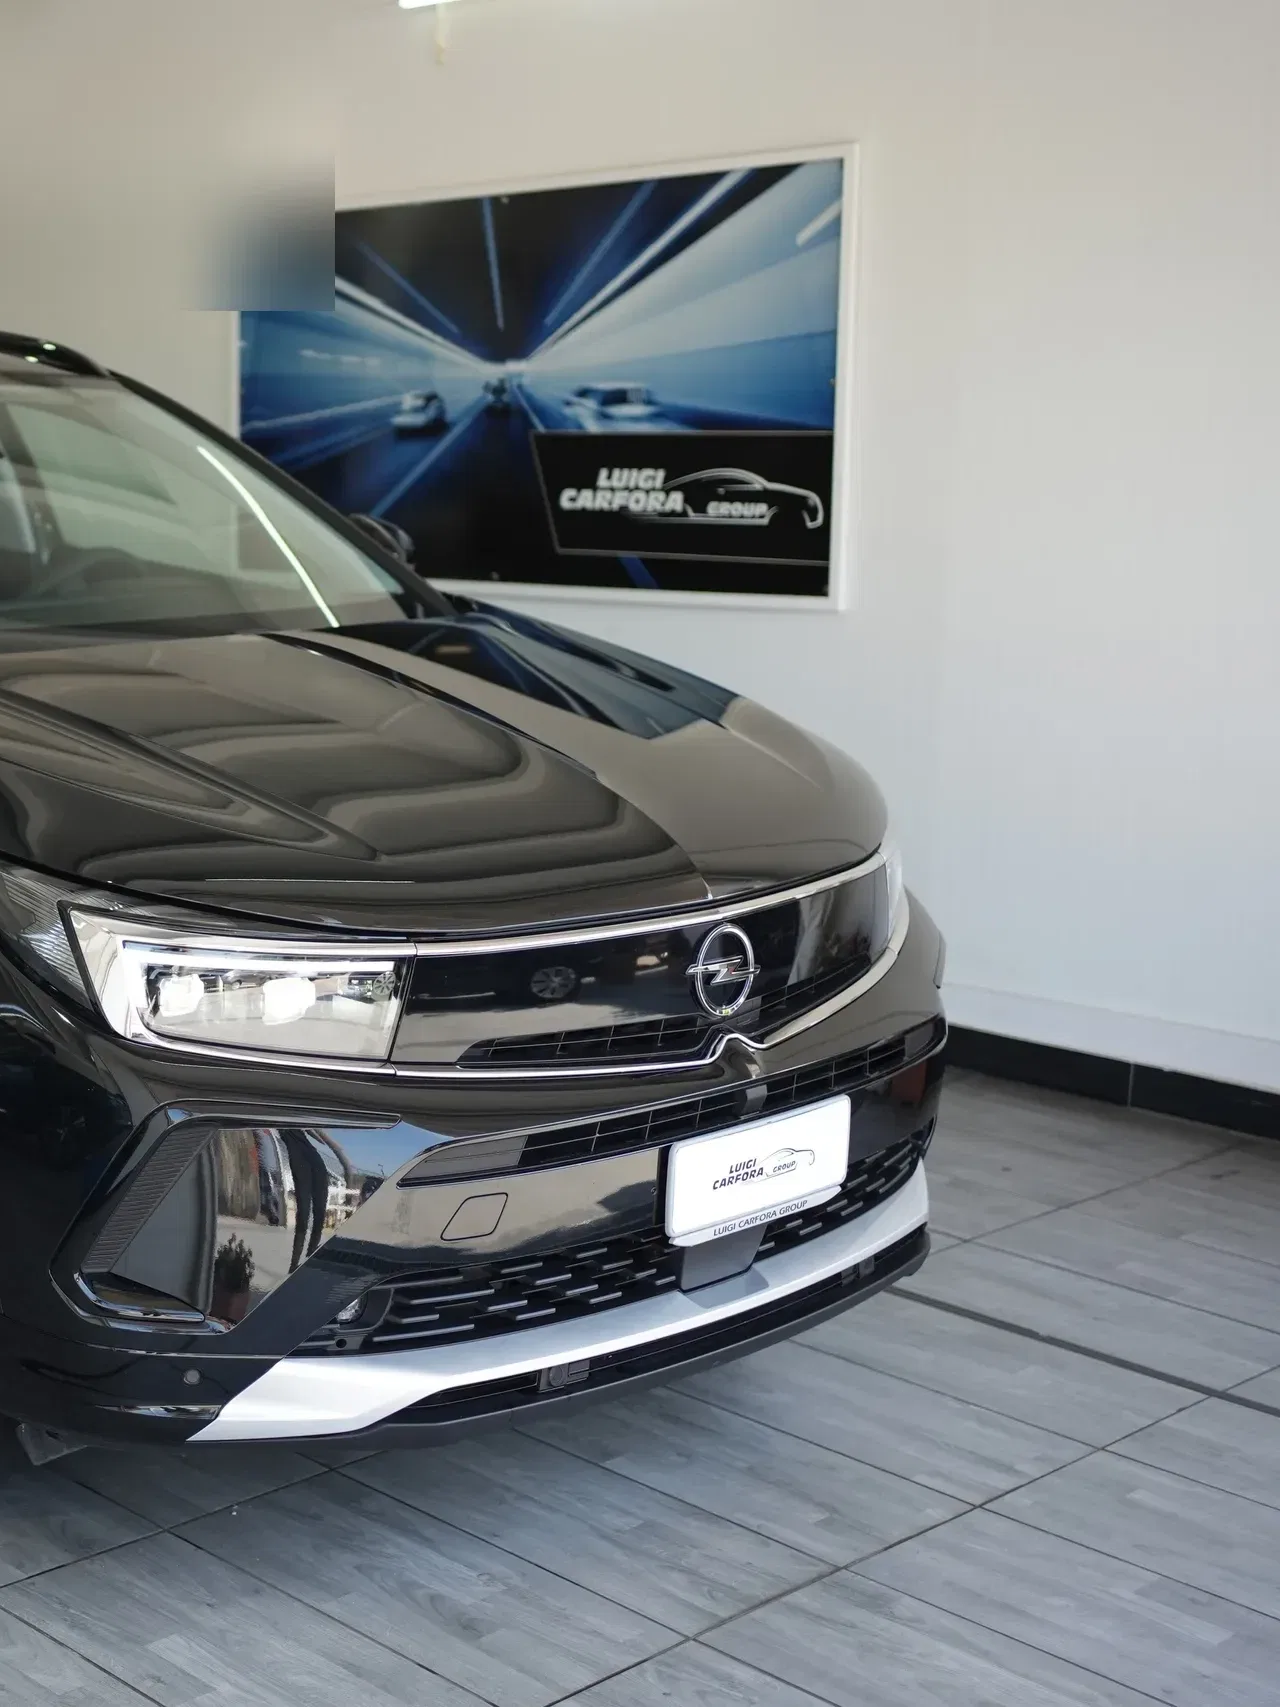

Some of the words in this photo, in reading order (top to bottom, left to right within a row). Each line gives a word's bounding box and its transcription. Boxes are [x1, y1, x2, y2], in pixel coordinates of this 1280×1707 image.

[596, 467, 666, 489] LUIGI
[559, 488, 684, 513] CARFORA
[706, 501, 768, 518] GROUP
[728, 1158, 757, 1174] LUIGI
[773, 1160, 796, 1173] GROUP
[713, 1167, 764, 1190] CARFORA
[714, 1223, 736, 1236] LUIGI
[738, 1211, 777, 1228] CARFORA
[780, 1200, 808, 1215] GROUP
